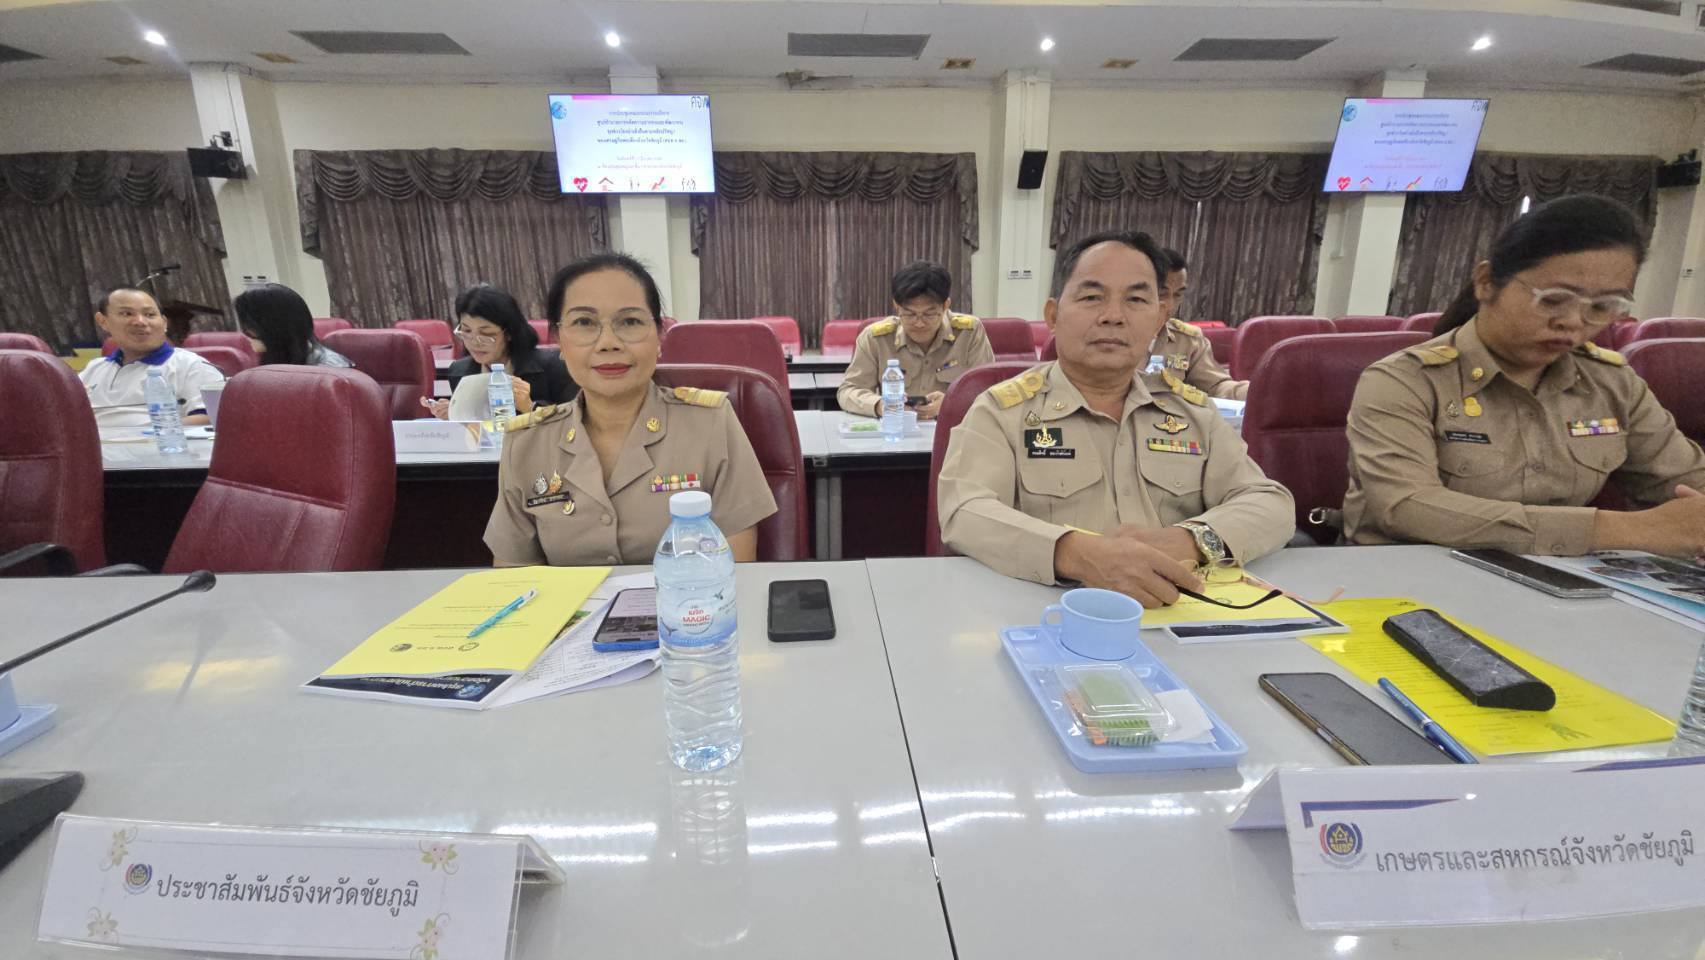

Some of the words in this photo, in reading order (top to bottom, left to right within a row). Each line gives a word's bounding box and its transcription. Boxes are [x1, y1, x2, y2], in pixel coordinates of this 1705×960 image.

[682, 614, 711, 623] MAGIC
[1376, 829, 1695, 872] เกษตรและสหกรณ์จังหวัดชัยภูมิ
[157, 873, 419, 917] ประชาสัมพันธ์จังหวัดชัยภูมิ
